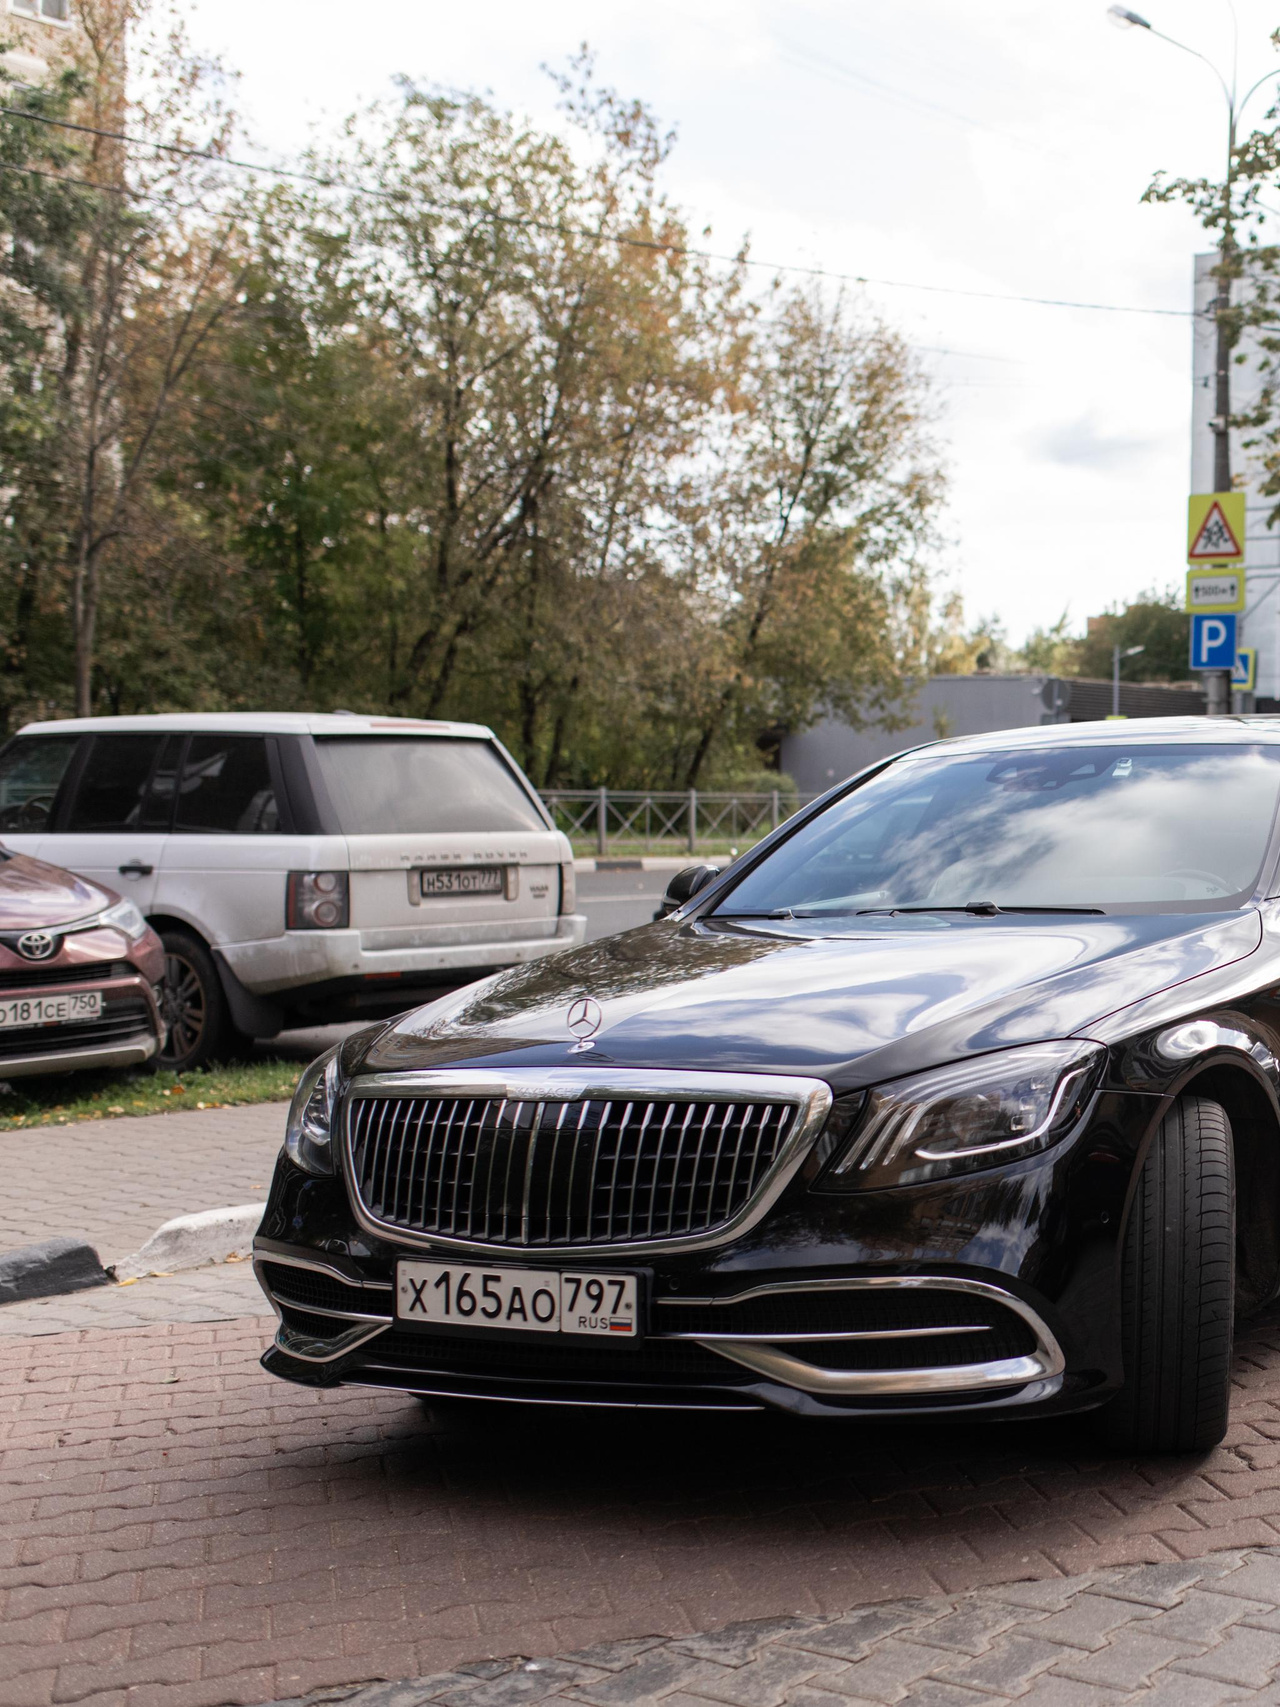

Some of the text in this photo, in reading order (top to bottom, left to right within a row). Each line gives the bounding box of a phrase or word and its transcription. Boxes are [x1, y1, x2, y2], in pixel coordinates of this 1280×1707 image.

[1201, 619, 1227, 663] P
[71, 994, 97, 1011] 750
[408, 1270, 626, 1323] Х165АО 797
[578, 1316, 608, 1330] RUS
